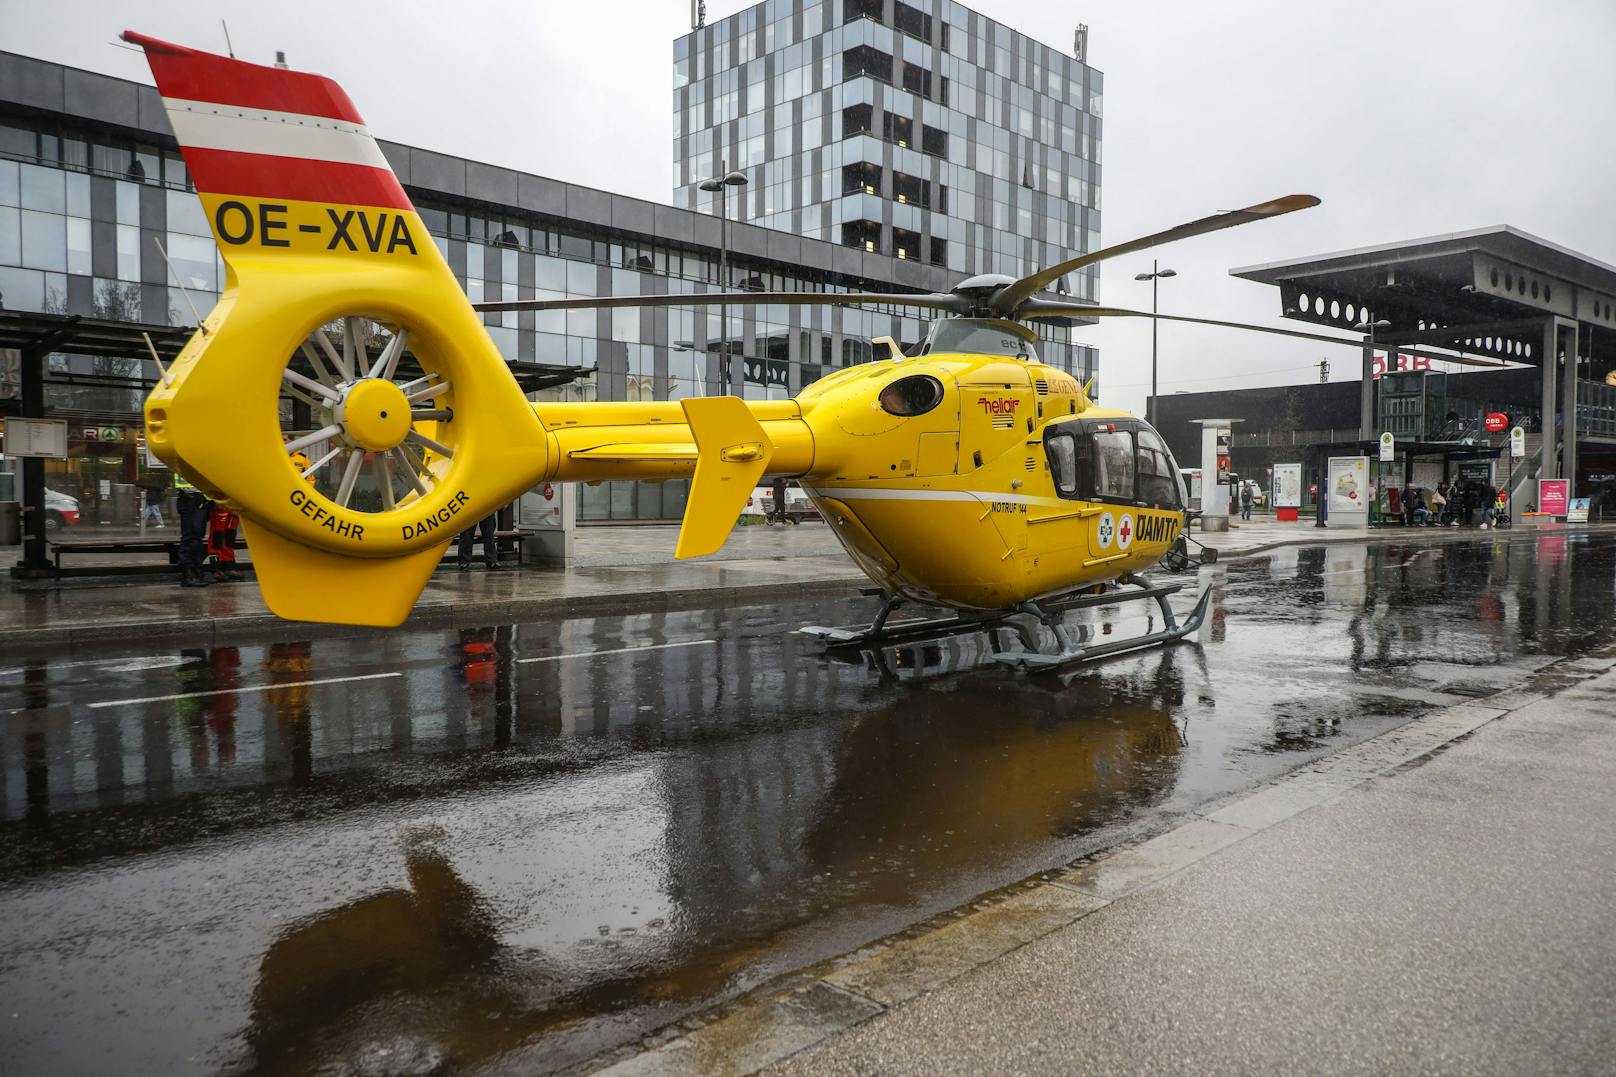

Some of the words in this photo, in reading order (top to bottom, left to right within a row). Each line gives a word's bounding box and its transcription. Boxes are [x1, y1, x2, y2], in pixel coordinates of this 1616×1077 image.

[216, 201, 417, 255] OE-XVA
[977, 397, 1020, 415] heliair
[289, 490, 365, 541] GEFAHR
[402, 490, 471, 541] DANGER
[992, 502, 1017, 513] NOTRUF
[1019, 504, 1027, 514] 144
[1136, 514, 1178, 543] ÖAMTC
